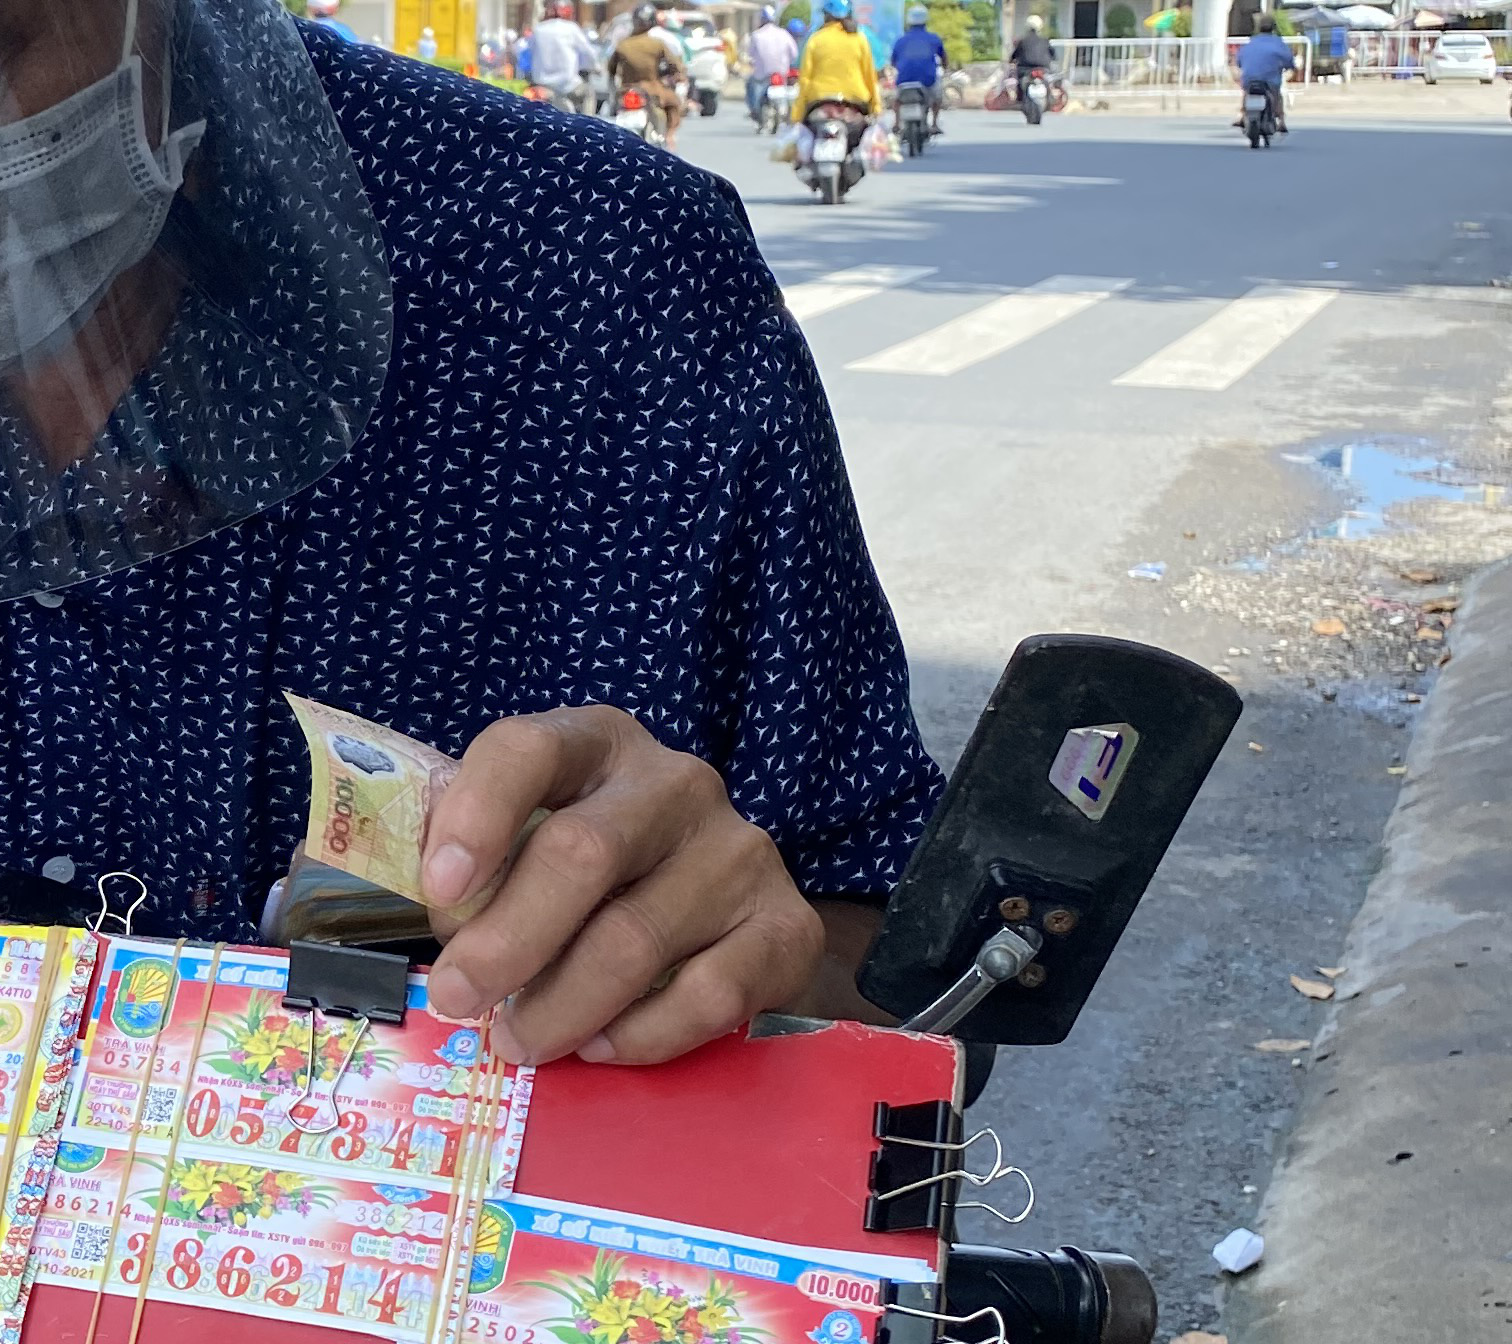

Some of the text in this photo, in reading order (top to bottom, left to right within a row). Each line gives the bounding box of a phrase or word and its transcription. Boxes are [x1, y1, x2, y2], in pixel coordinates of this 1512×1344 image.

[187, 1088, 457, 1178] 057341
[69, 1177, 101, 1193] VINH
[121, 1232, 405, 1327] 386214
[808, 1272, 876, 1303] 10.000
